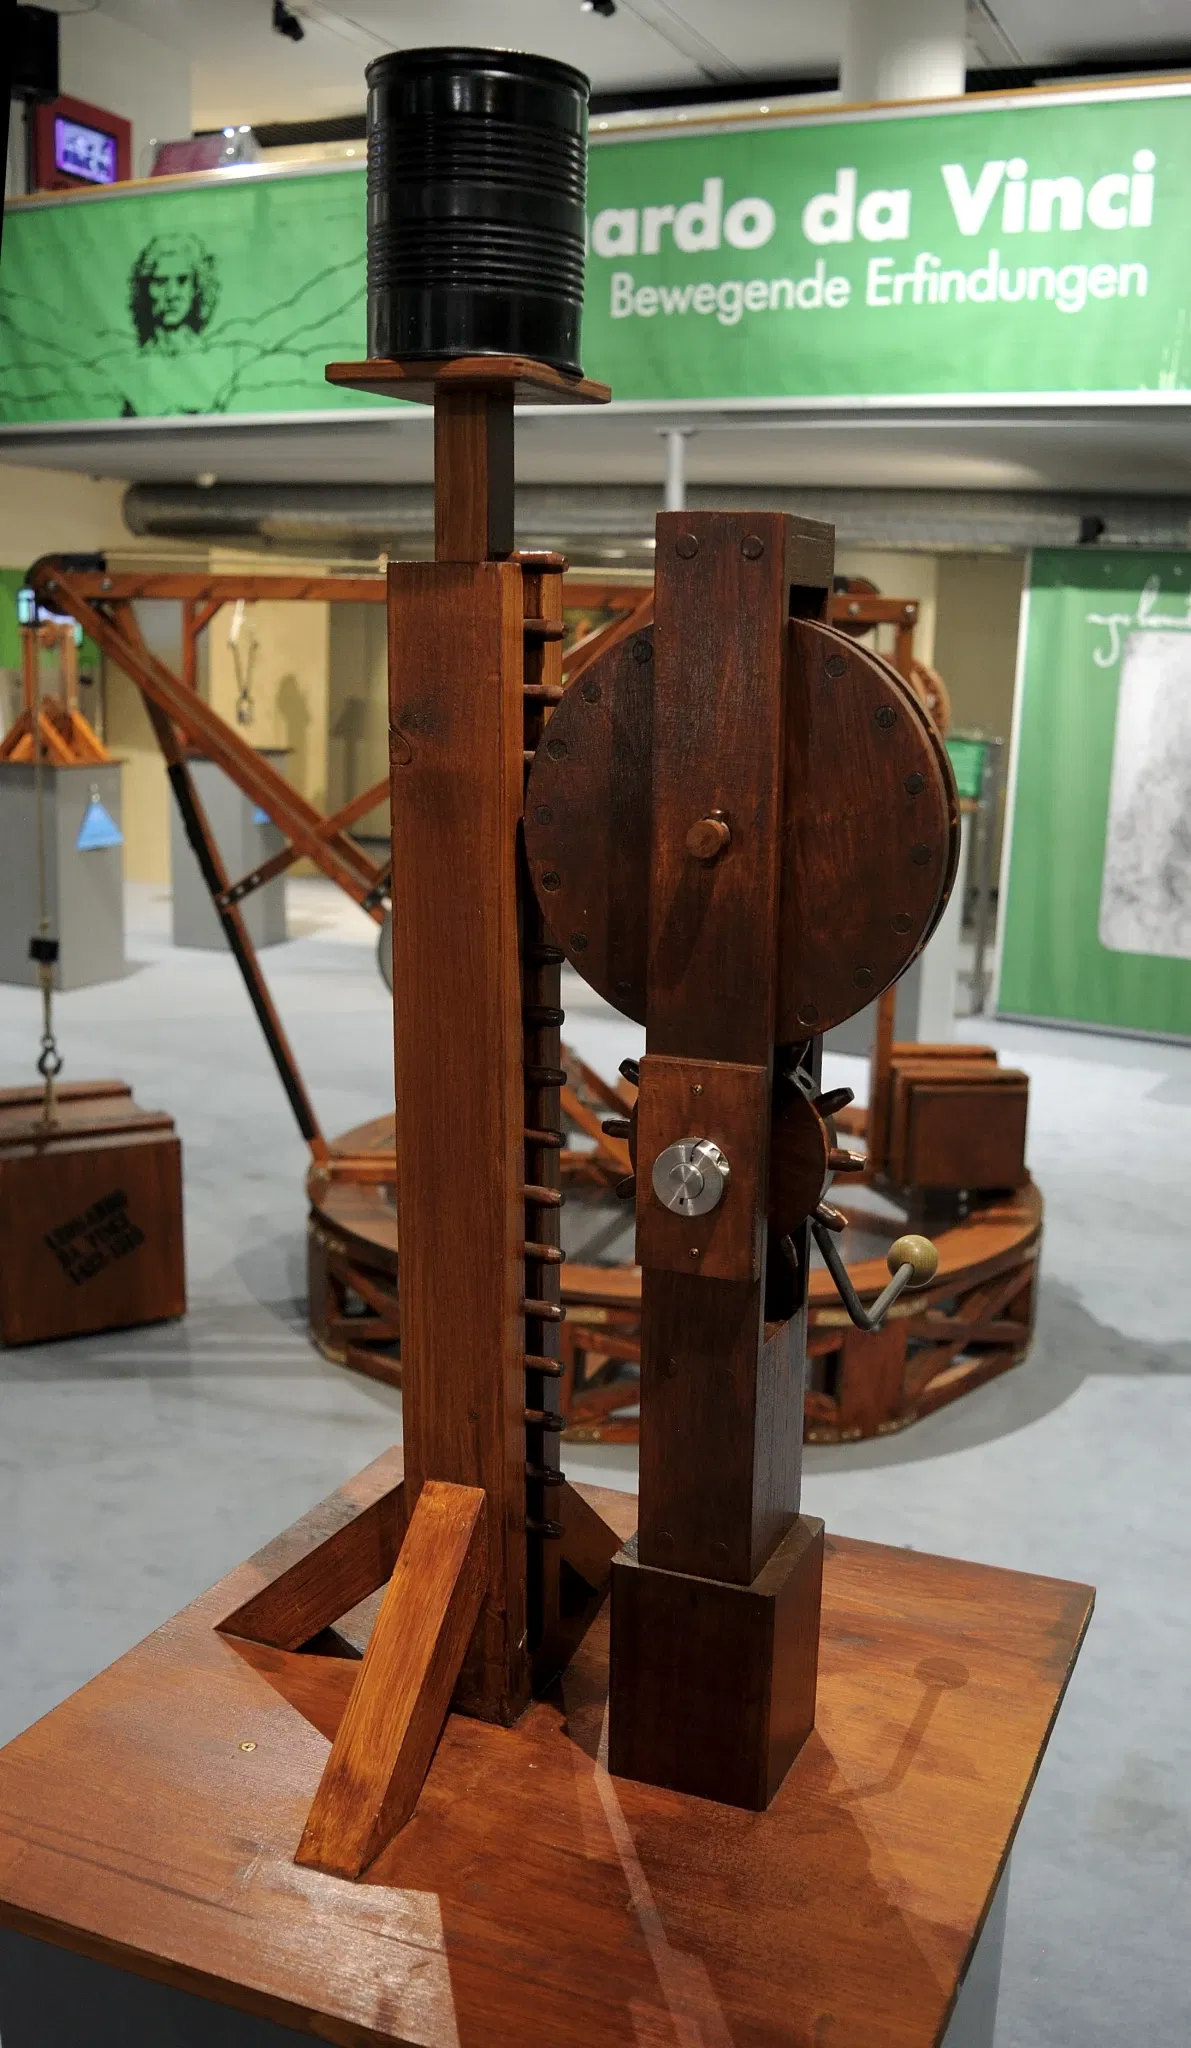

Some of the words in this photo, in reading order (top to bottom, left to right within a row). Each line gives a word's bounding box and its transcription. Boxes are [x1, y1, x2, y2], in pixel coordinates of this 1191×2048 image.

[801, 168, 912, 246] da
[941, 149, 1157, 236] Vinci
[610, 258, 852, 326] Bewegende
[865, 248, 1150, 314] Erfindungen
